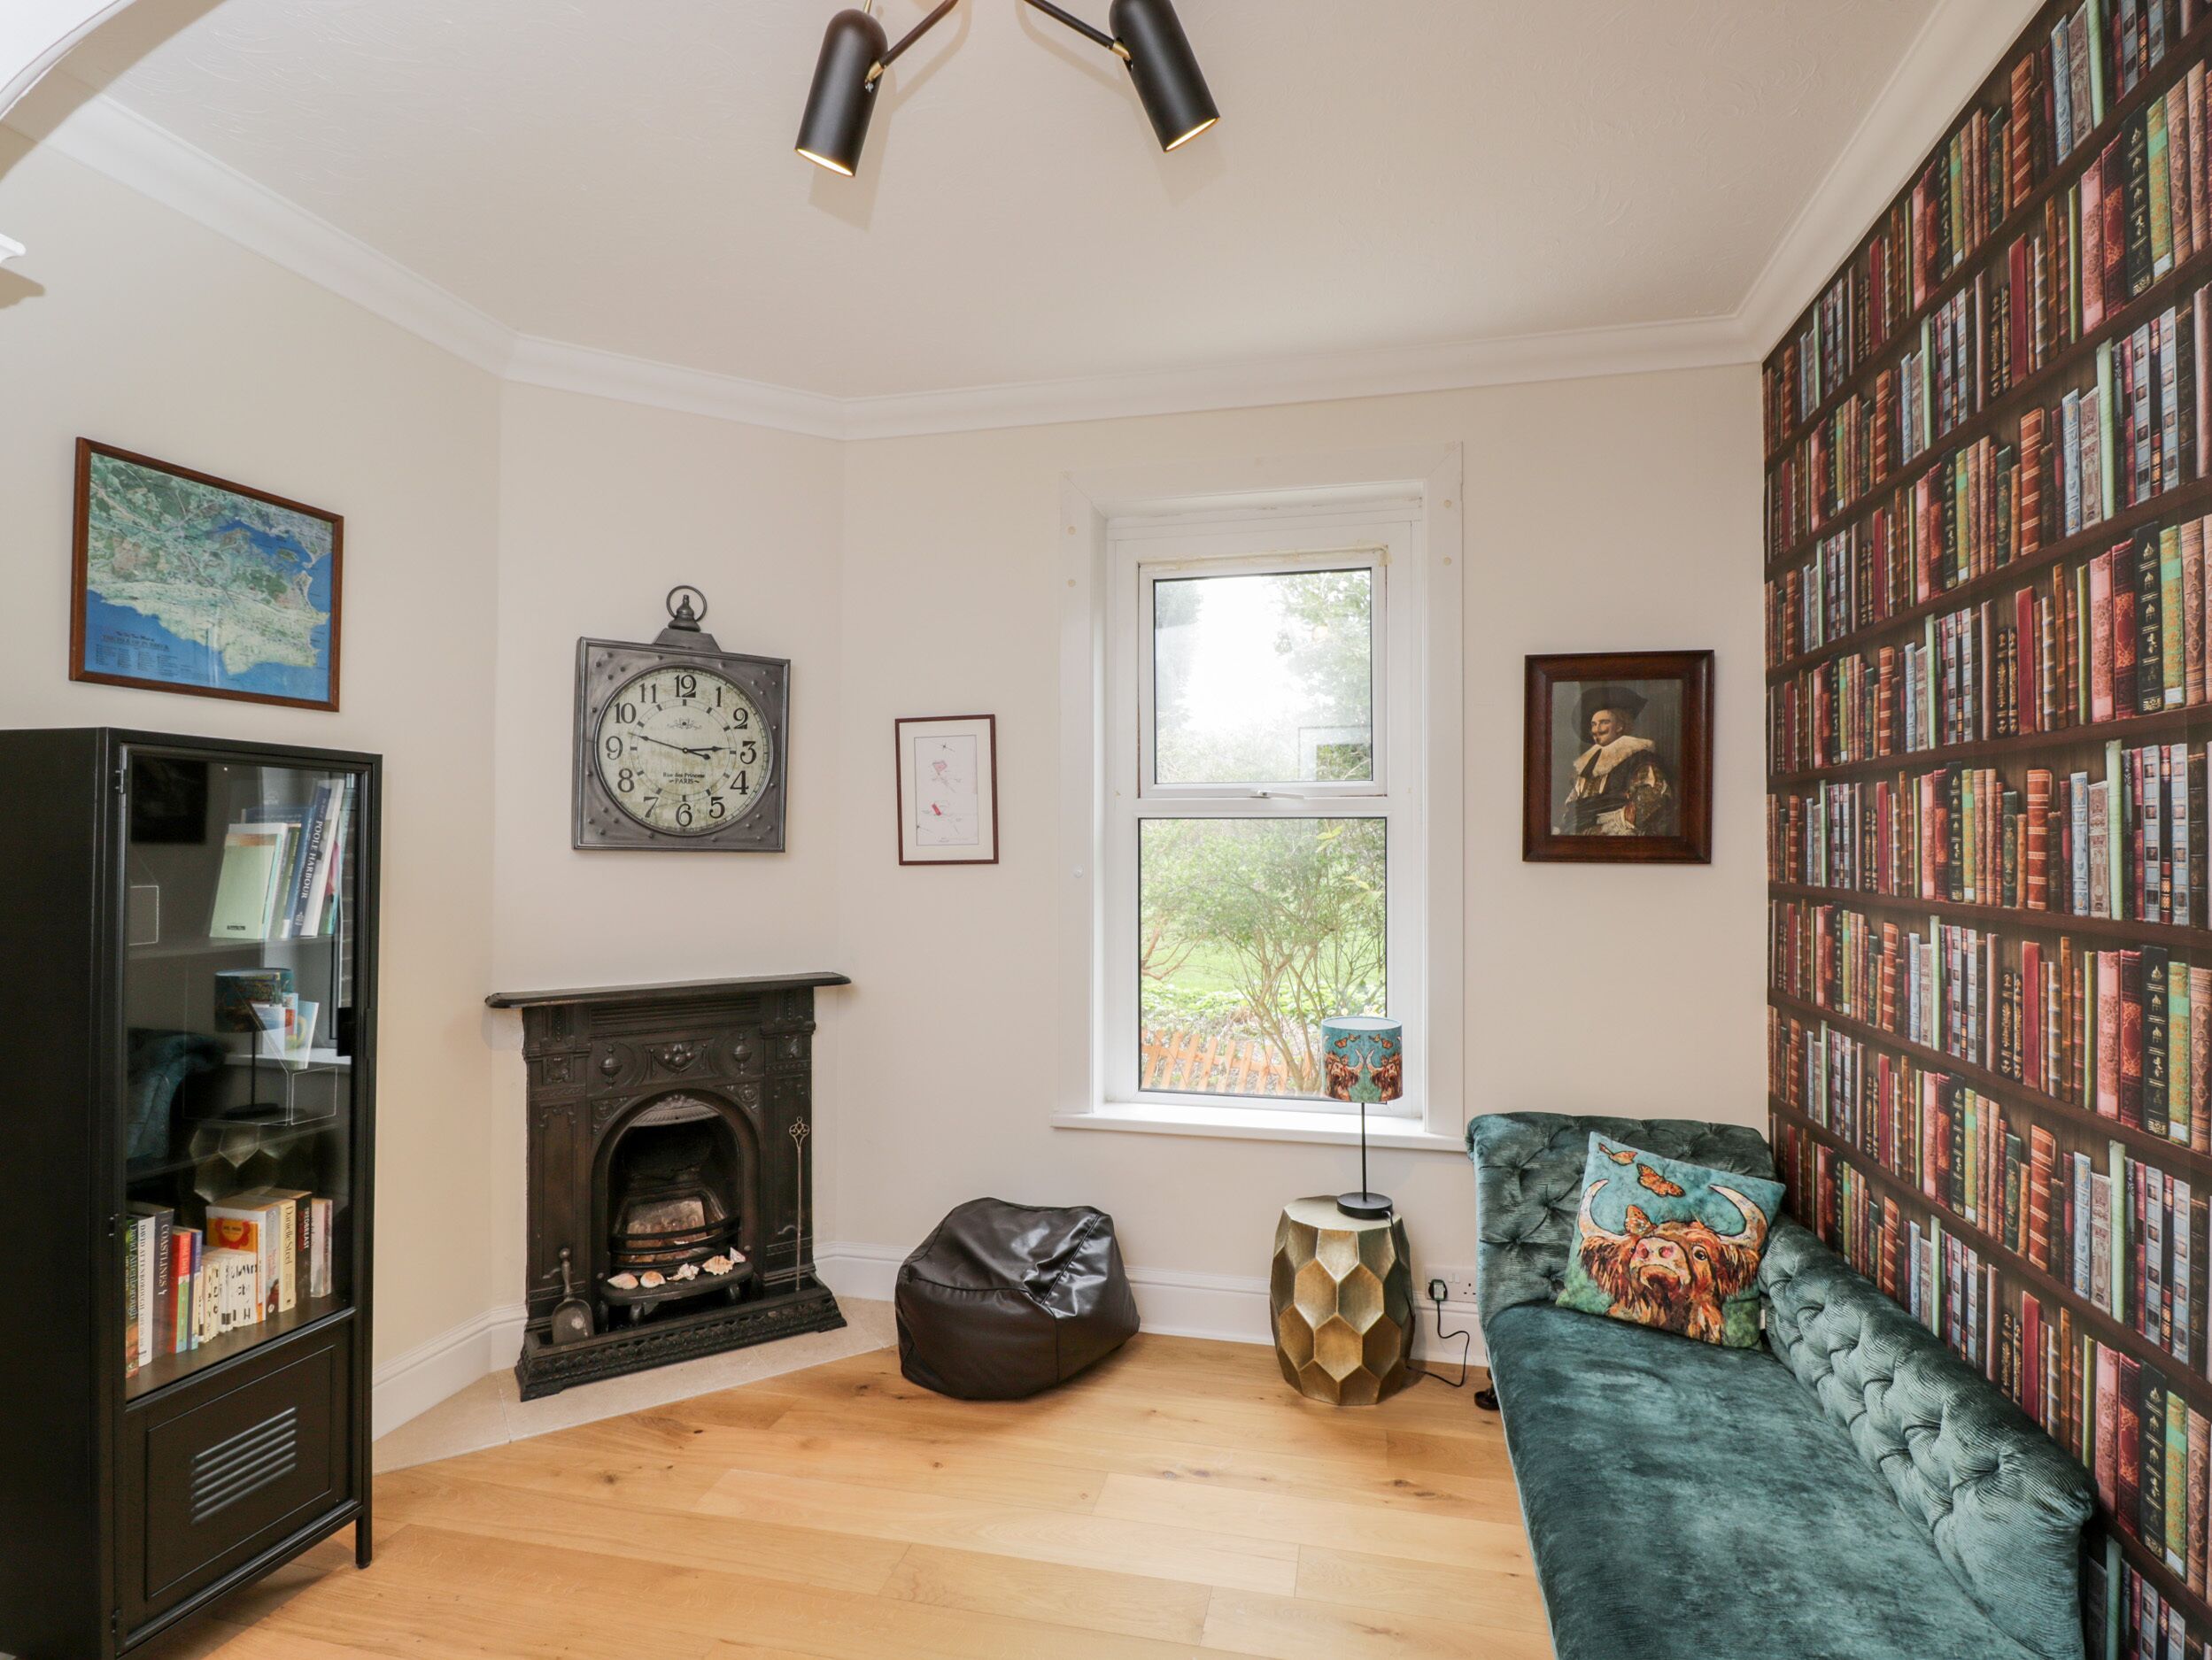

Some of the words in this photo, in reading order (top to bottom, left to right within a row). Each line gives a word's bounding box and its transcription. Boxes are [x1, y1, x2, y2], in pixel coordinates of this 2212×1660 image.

[639, 683, 658, 704] 11
[674, 675, 697, 699] 12
[715, 686, 723, 708] 1
[615, 702, 637, 724] 10
[733, 707, 749, 730] 2
[606, 736, 623, 761] 9
[739, 740, 757, 765] 3
[617, 768, 635, 793] 8
[730, 770, 749, 795] 4
[643, 797, 659, 819] 7
[676, 803, 692, 827] 6
[709, 797, 726, 819] 5
[310, 820, 323, 850] POOLE
[301, 853, 317, 899] HARBOUR
[285, 1206, 294, 1241] Danielle
[129, 1224, 138, 1252] David
[159, 1224, 170, 1287] COASTLINES
[128, 1254, 138, 1320] Attenborough
